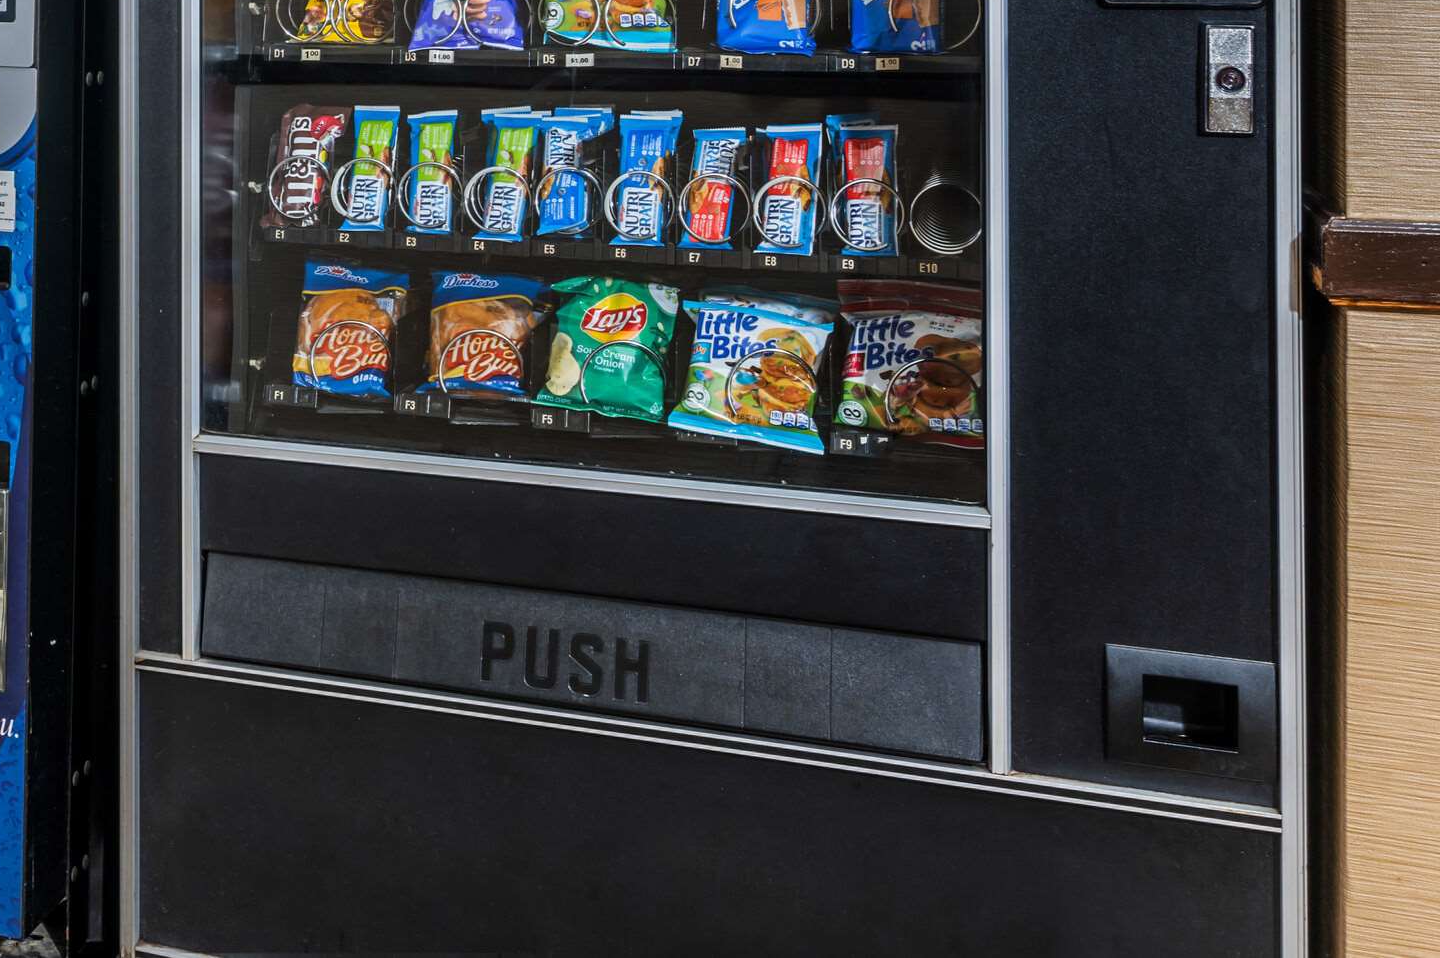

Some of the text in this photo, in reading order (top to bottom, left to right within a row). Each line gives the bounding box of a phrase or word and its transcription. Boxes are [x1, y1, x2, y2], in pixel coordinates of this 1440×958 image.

[274, 48, 285, 59] D1
[404, 51, 417, 63] D3
[542, 54, 556, 65] D5
[687, 56, 701, 68] D7
[841, 58, 855, 69] D9
[624, 190, 640, 237] NUTRI
[766, 198, 793, 245] NUTRI GRAIN
[275, 230, 285, 240] E1
[339, 232, 350, 243] E2
[406, 237, 417, 247] E3
[473, 241, 485, 251] E4
[544, 244, 556, 255] E5
[615, 248, 626, 259] E6
[688, 252, 701, 263] E7
[764, 256, 777, 267] E8
[841, 259, 855, 270] E9
[919, 263, 939, 274] E10
[442, 274, 499, 289] Duchess
[586, 305, 645, 333] Lay's
[695, 310, 759, 340] Little
[850, 315, 915, 351] Little
[711, 334, 778, 360] Bites
[602, 348, 636, 363] Cream
[865, 342, 934, 370] Bites
[332, 345, 388, 378] Bun
[467, 352, 520, 381] Bun
[595, 355, 625, 369] Onion
[274, 390, 284, 400] F1
[405, 399, 416, 410] F3
[542, 414, 553, 425] F5
[840, 439, 852, 450] F9
[479, 618, 650, 705] PUSH
